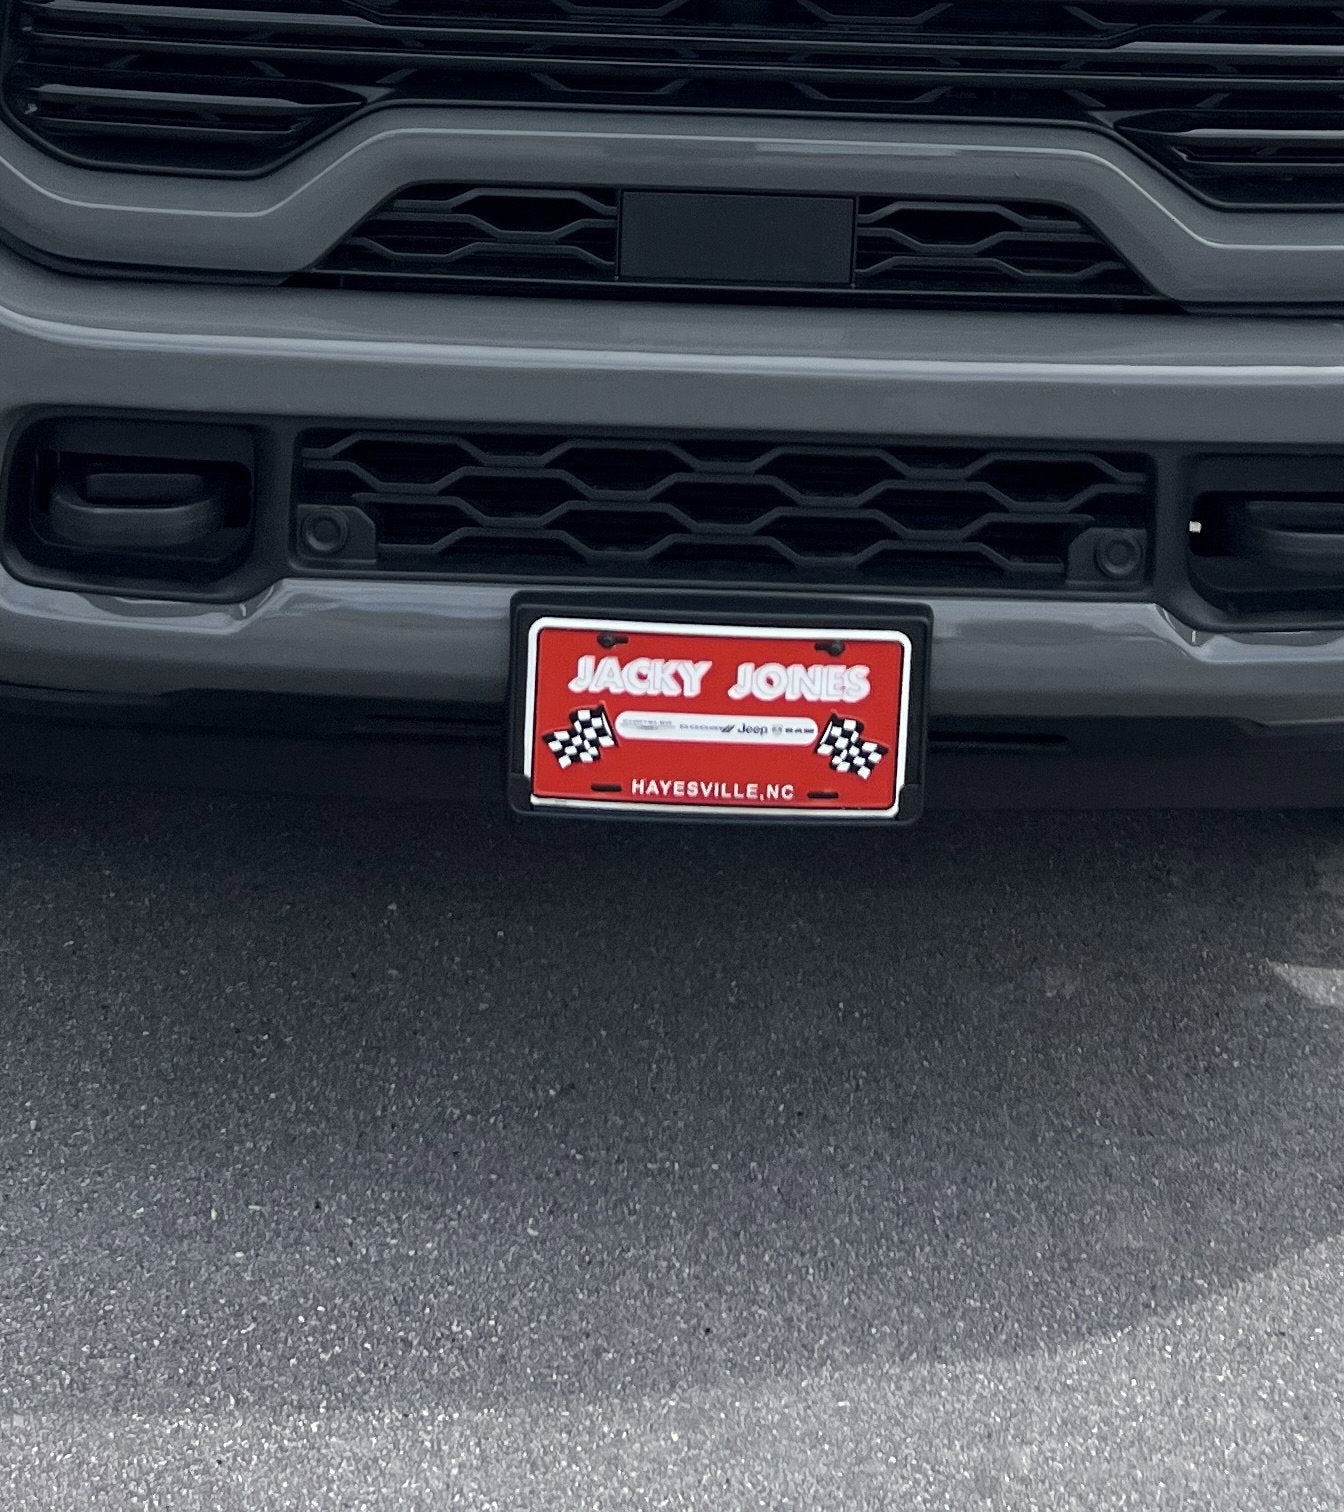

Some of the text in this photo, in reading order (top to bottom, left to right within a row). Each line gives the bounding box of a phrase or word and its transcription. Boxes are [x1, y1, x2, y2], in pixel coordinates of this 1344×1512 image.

[568, 655, 871, 702] JACKY JONES
[737, 723, 768, 736] Jeep
